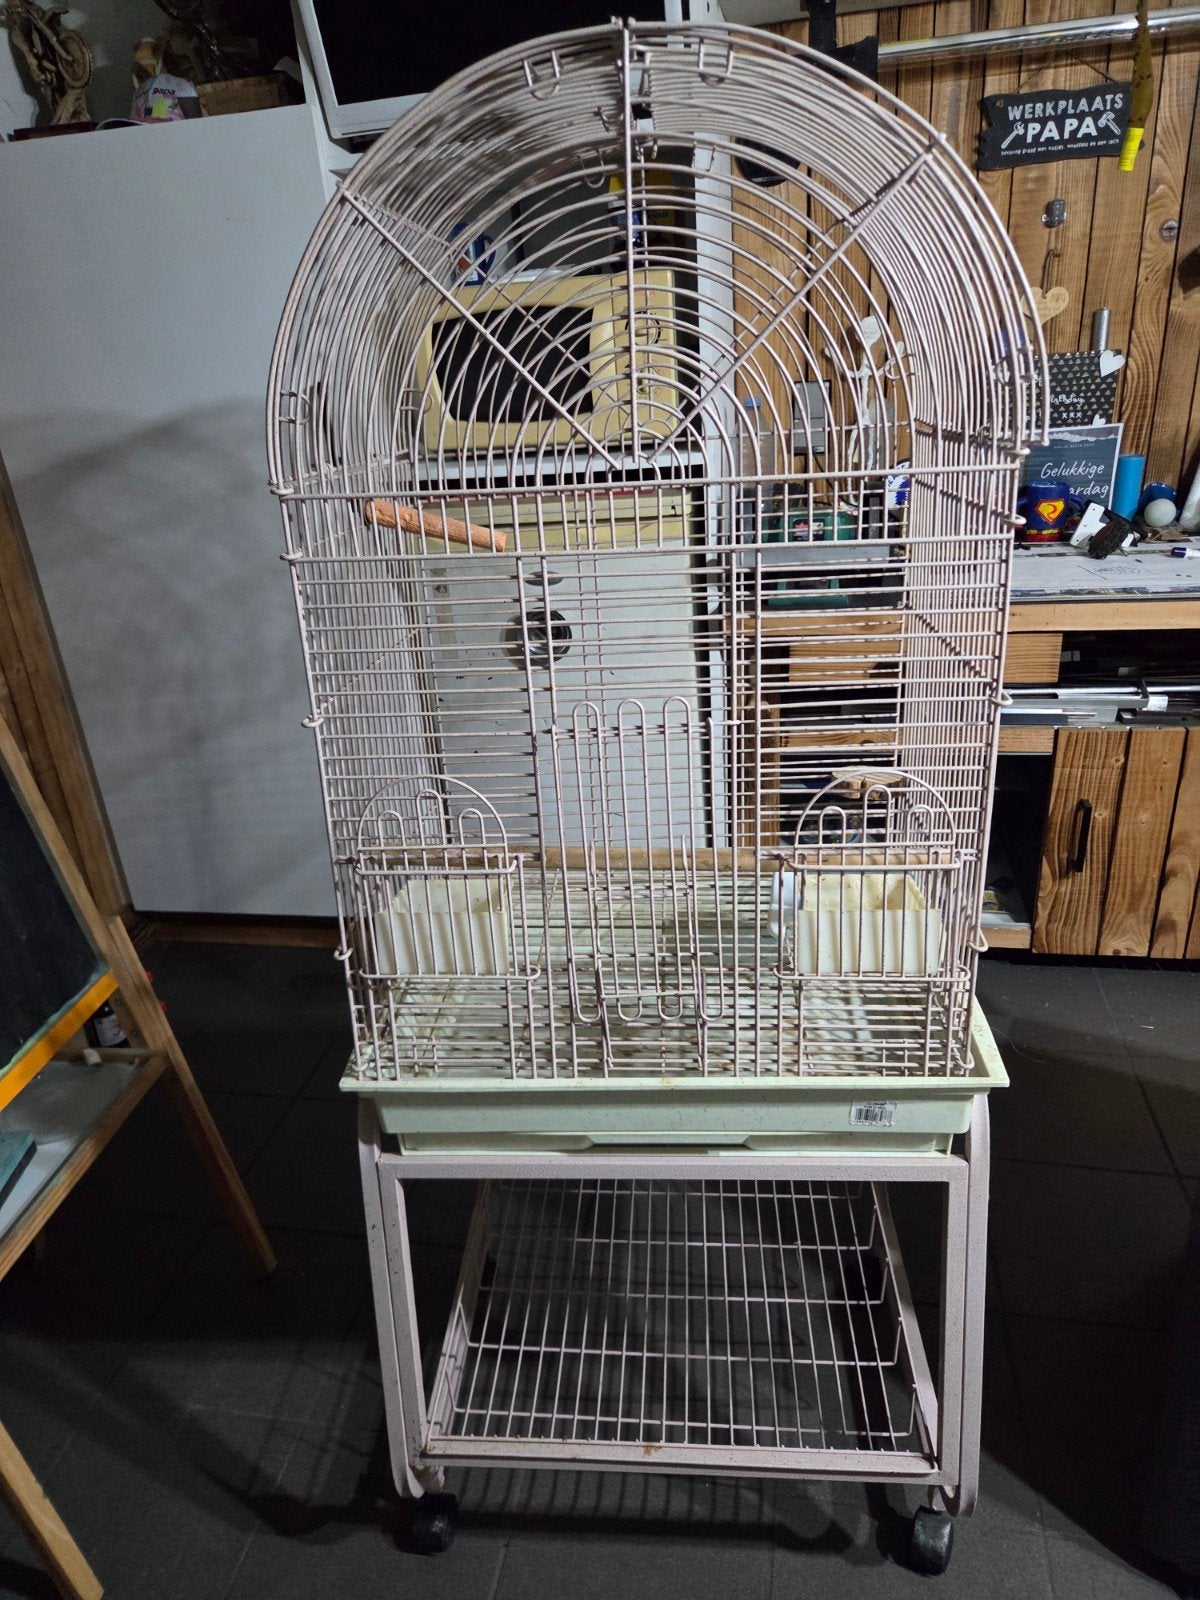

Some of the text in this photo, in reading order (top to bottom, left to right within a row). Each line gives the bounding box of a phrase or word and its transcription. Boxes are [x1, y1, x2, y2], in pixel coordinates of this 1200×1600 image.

[153, 87, 176, 96] papa
[1007, 93, 1124, 121] WERKPLAATS
[1026, 116, 1098, 143] PAPA
[1040, 460, 1105, 479] Gelukkige
